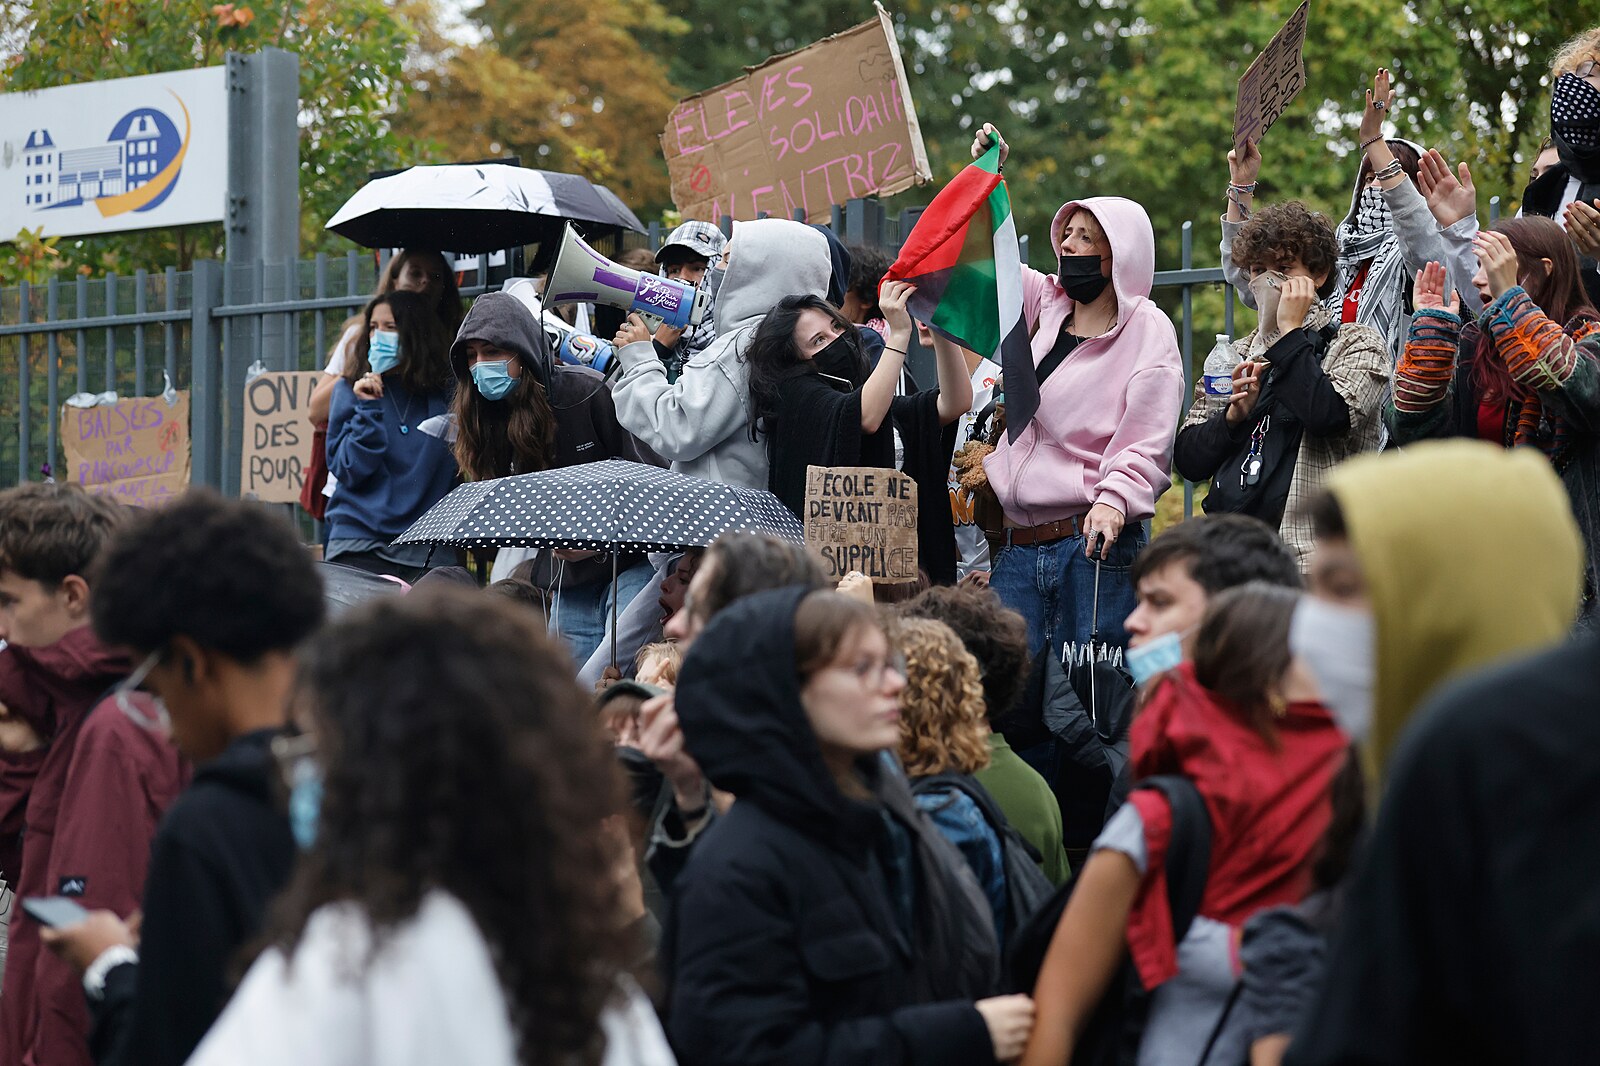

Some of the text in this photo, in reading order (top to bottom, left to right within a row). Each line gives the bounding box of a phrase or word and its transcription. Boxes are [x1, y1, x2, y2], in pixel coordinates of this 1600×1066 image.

[249, 375, 298, 415] ON
[105, 434, 136, 459] PAR
[255, 421, 299, 450] DES
[250, 456, 304, 490] POUR
[887, 477, 911, 499] NE
[810, 501, 917, 529] DEVRAIT PAS
[861, 526, 887, 549] UN
[821, 545, 915, 578] SUPPLICE
